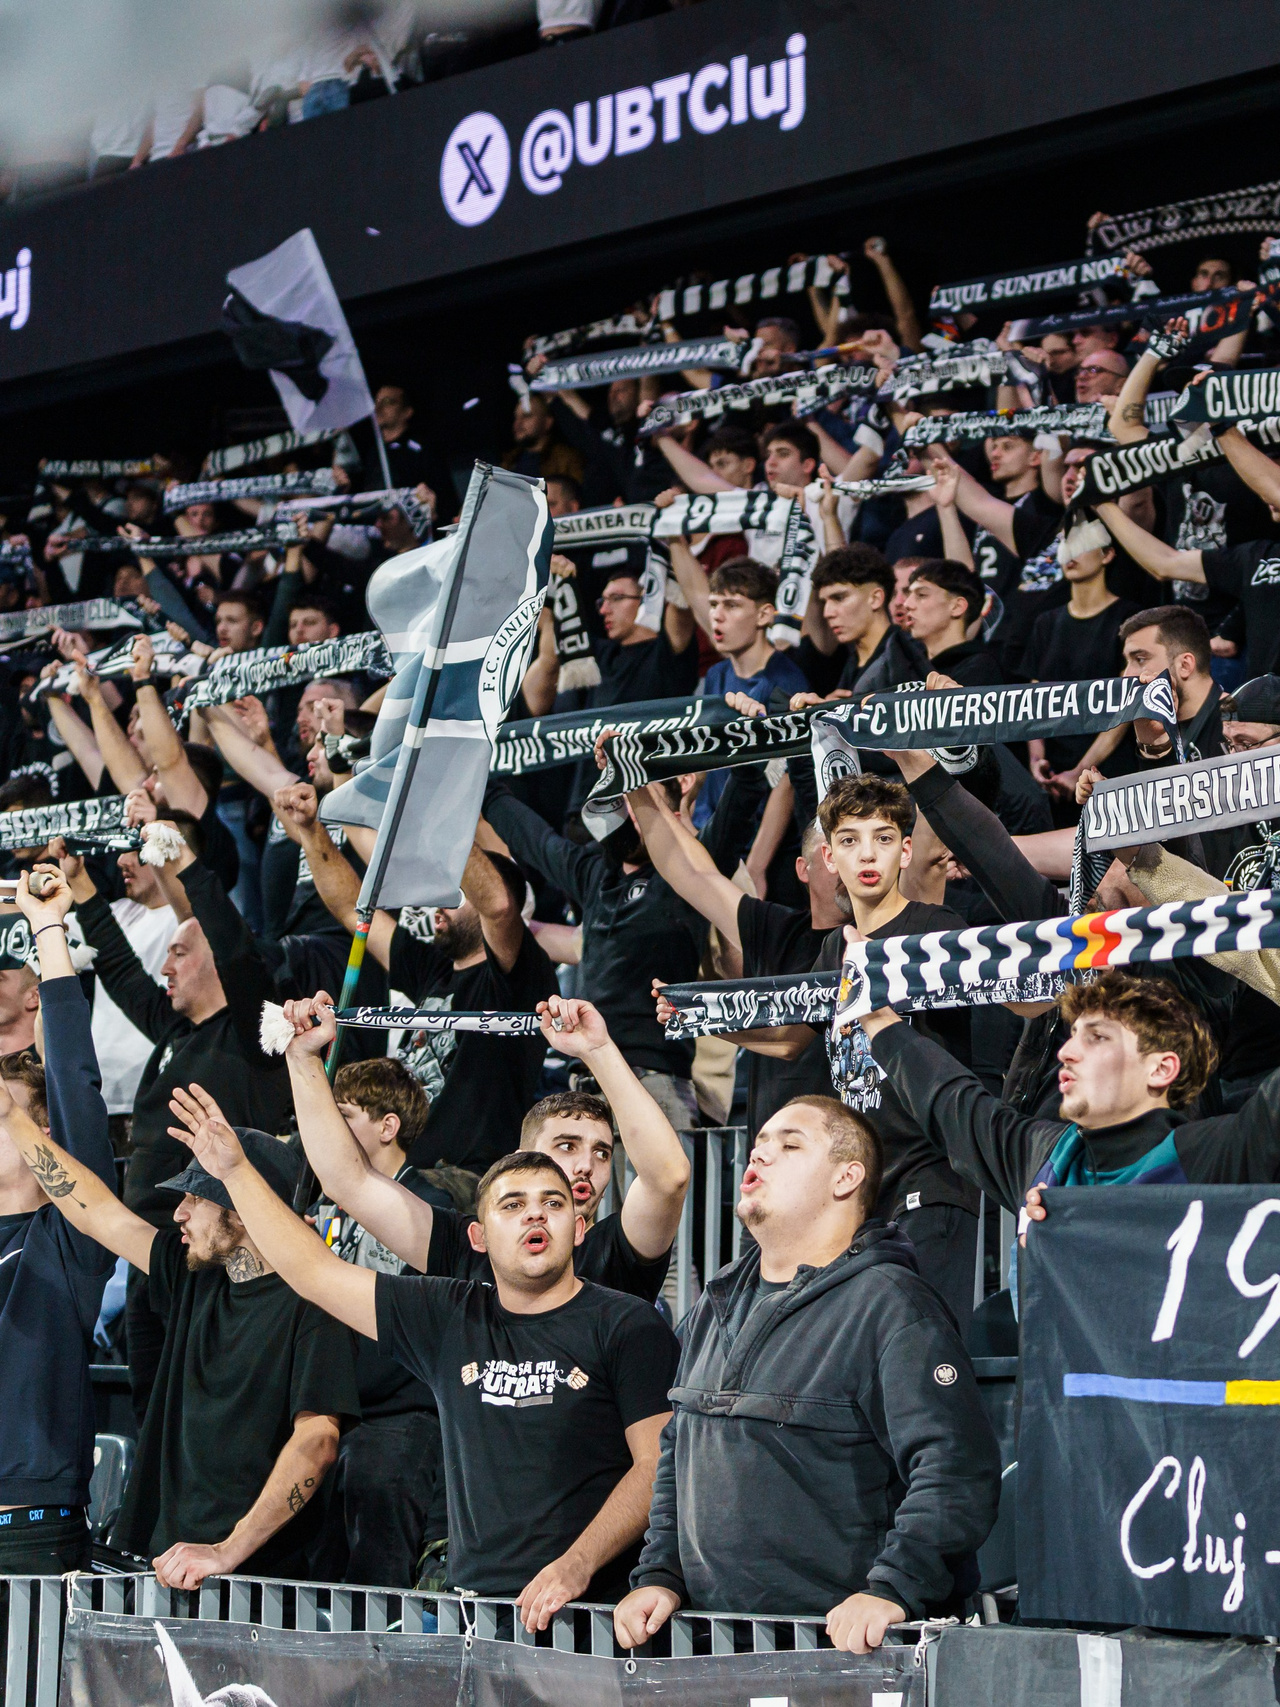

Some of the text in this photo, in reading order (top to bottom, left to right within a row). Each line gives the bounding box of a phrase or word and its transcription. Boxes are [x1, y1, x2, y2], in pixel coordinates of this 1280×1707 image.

[519, 32, 807, 196] @UBTCluj
[991, 268, 1075, 299] SUNTEM
[630, 512, 648, 527] CL
[979, 545, 998, 578] 2
[482, 655, 500, 693] F.C.
[853, 700, 889, 736] FC
[895, 682, 1081, 733] UNIVERSITATEA
[643, 725, 722, 759] ALB
[535, 1360, 556, 1375] FIU
[29, 1509, 45, 1521] CR7
[1120, 1455, 1247, 1613] Cluj
